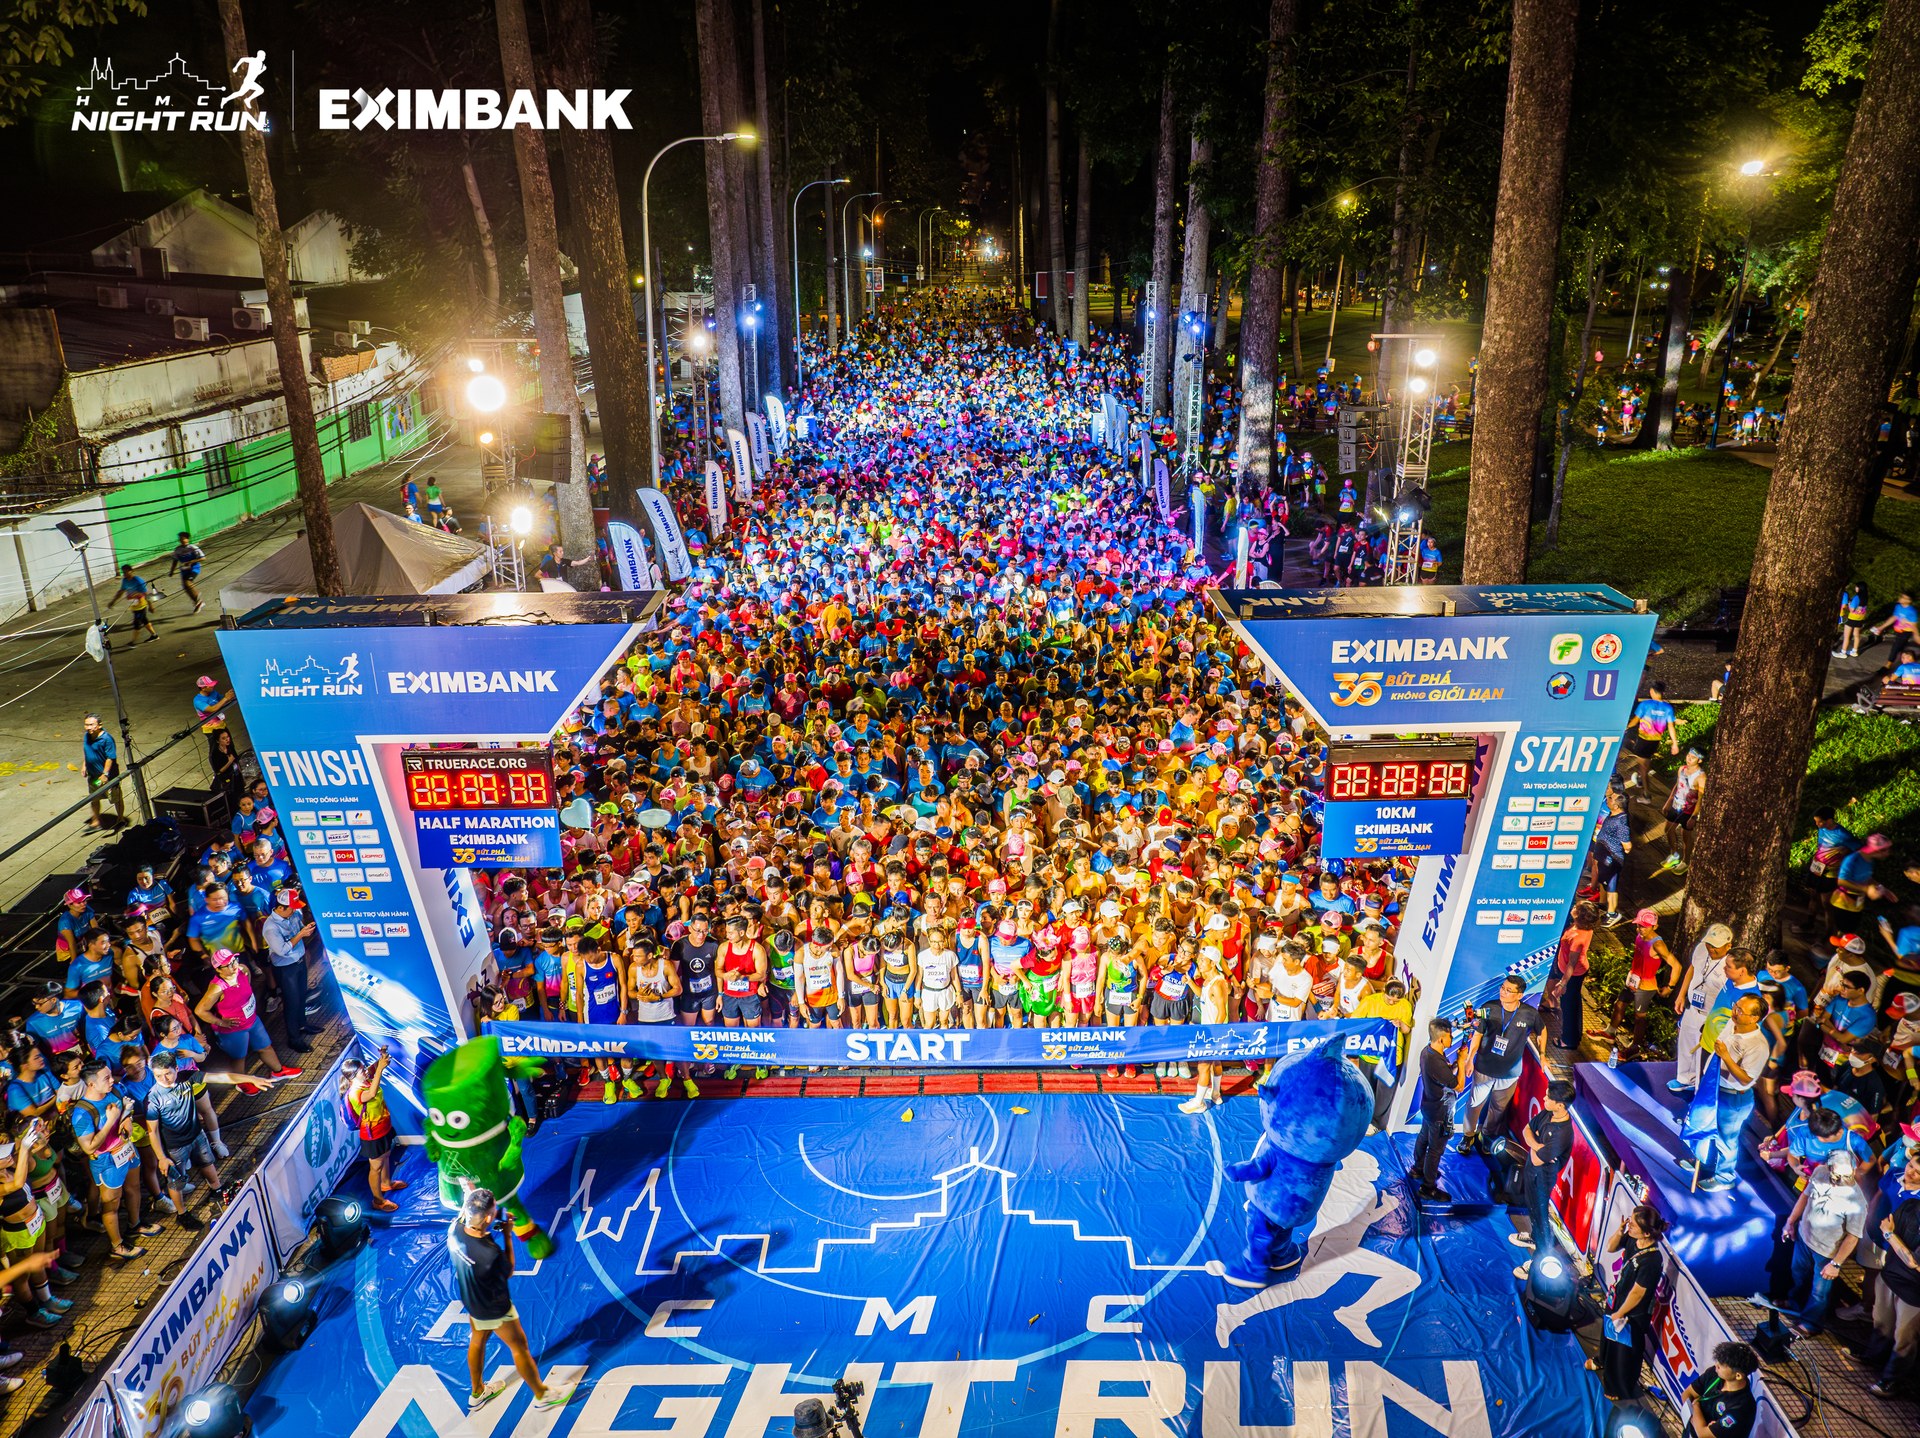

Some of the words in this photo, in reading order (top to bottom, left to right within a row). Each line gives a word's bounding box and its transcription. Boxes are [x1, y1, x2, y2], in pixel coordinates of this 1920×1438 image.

[735, 440, 745, 476] EXIMBANK
[1157, 469, 1167, 509] EXIMBANK
[651, 499, 675, 543] EXIMBANK
[623, 538, 641, 590] EXIMBANK
[276, 601, 473, 616] EXIMBAN
[1331, 636, 1511, 664] EXIMBANK
[388, 670, 559, 694] EXIMBANK
[1330, 671, 1384, 707] 35
[1385, 671, 1416, 686] BỨT
[1419, 670, 1452, 685] PHÁ
[1593, 673, 1612, 697] U
[261, 685, 320, 698] NIGHT
[322, 684, 363, 696] RUN
[1390, 690, 1426, 700] KHÔNG
[1428, 687, 1465, 701] GIỚI
[1468, 687, 1505, 703] HẠN
[1514, 735, 1621, 773] START
[260, 750, 370, 786] FINISH
[425, 758, 527, 770] TRUERACE.ORG
[1376, 806, 1417, 819] 10KM
[419, 817, 461, 829] HALF
[464, 816, 556, 829] MARATHON
[1354, 823, 1434, 835] EXIMBANK
[449, 834, 529, 845] EXIMBANK
[1354, 838, 1379, 853] 35
[452, 848, 477, 863] 35
[1523, 874, 1540, 886] be
[350, 887, 368, 899] be
[1692, 992, 1705, 1003] BTC
[691, 1031, 776, 1043] EXIMBANK
[1041, 1031, 1126, 1043] EXIMBANK
[693, 1044, 719, 1060] 35
[846, 1033, 970, 1061] START
[1041, 1044, 1067, 1060] 35
[1234, 1047, 1267, 1056] RUN
[1493, 1040, 1508, 1051] BTC
[302, 1178, 326, 1220] GET
[325, 1131, 356, 1187] BODY
[123, 1207, 256, 1393] EXIMBANK
[180, 1328, 203, 1370] BỨT
[204, 1289, 228, 1330] PHÁ
[190, 1336, 217, 1378] KHÔNG
[216, 1299, 241, 1341] GIỚI
[242, 1265, 265, 1301] HẠN
[1054, 1360, 1492, 1438] RUN
